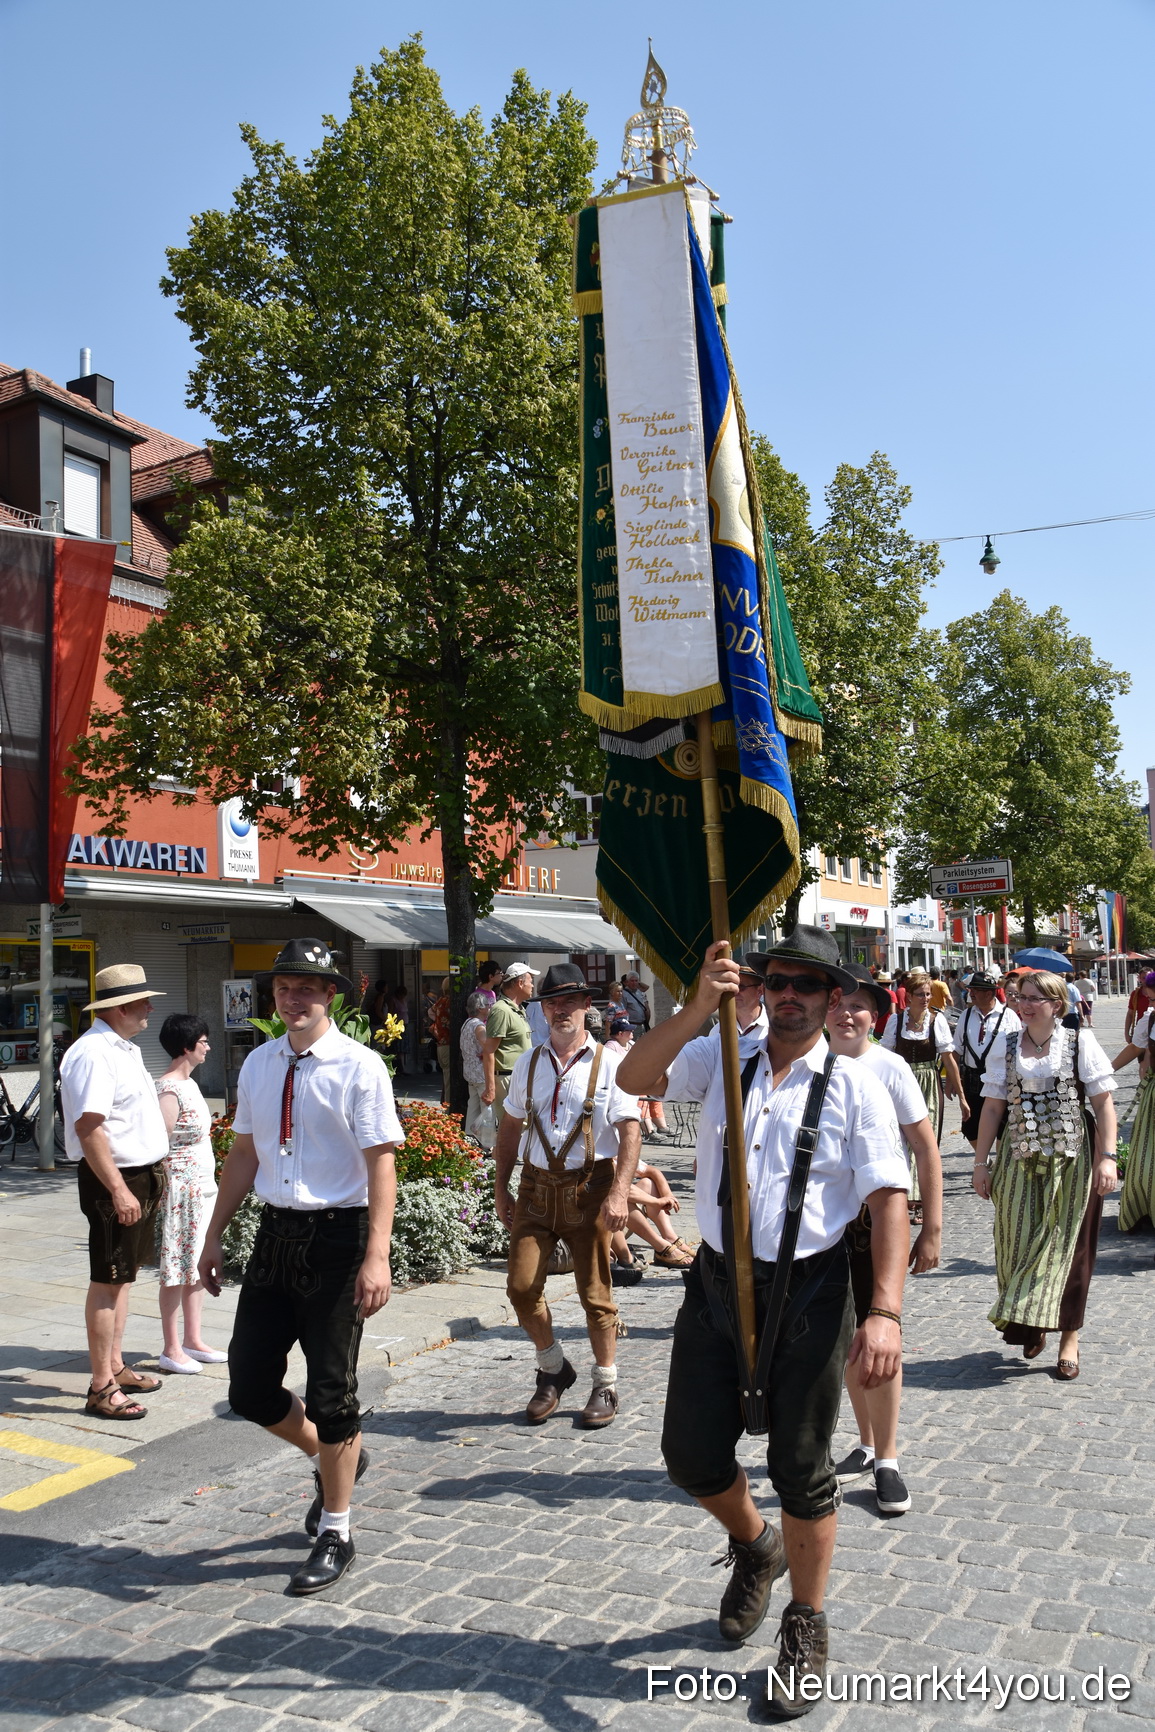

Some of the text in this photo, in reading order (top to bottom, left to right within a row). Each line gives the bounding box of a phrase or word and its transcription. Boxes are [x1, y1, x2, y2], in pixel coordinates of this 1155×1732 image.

[617, 411, 676, 425] Franziska
[643, 422, 694, 438] Bauer
[620, 445, 676, 461] Veronika
[637, 459, 695, 480] Geitner
[620, 483, 664, 497] Ottilie
[637, 495, 698, 515] Hafner
[623, 519, 688, 536] Sieglinde
[628, 530, 701, 552] Hollweck
[625, 555, 673, 572] Thekla
[640, 568, 705, 585] Tischner
[628, 594, 682, 613] Hedwig
[634, 607, 707, 623] Wittmann
[229, 848, 253, 860] PRESSE
[227, 862, 256, 873] THUMANN
[943, 866, 994, 878] Parkleitsystem
[962, 882, 997, 891] Rosengasse
[182, 926, 225, 936] NEUMARKTER
